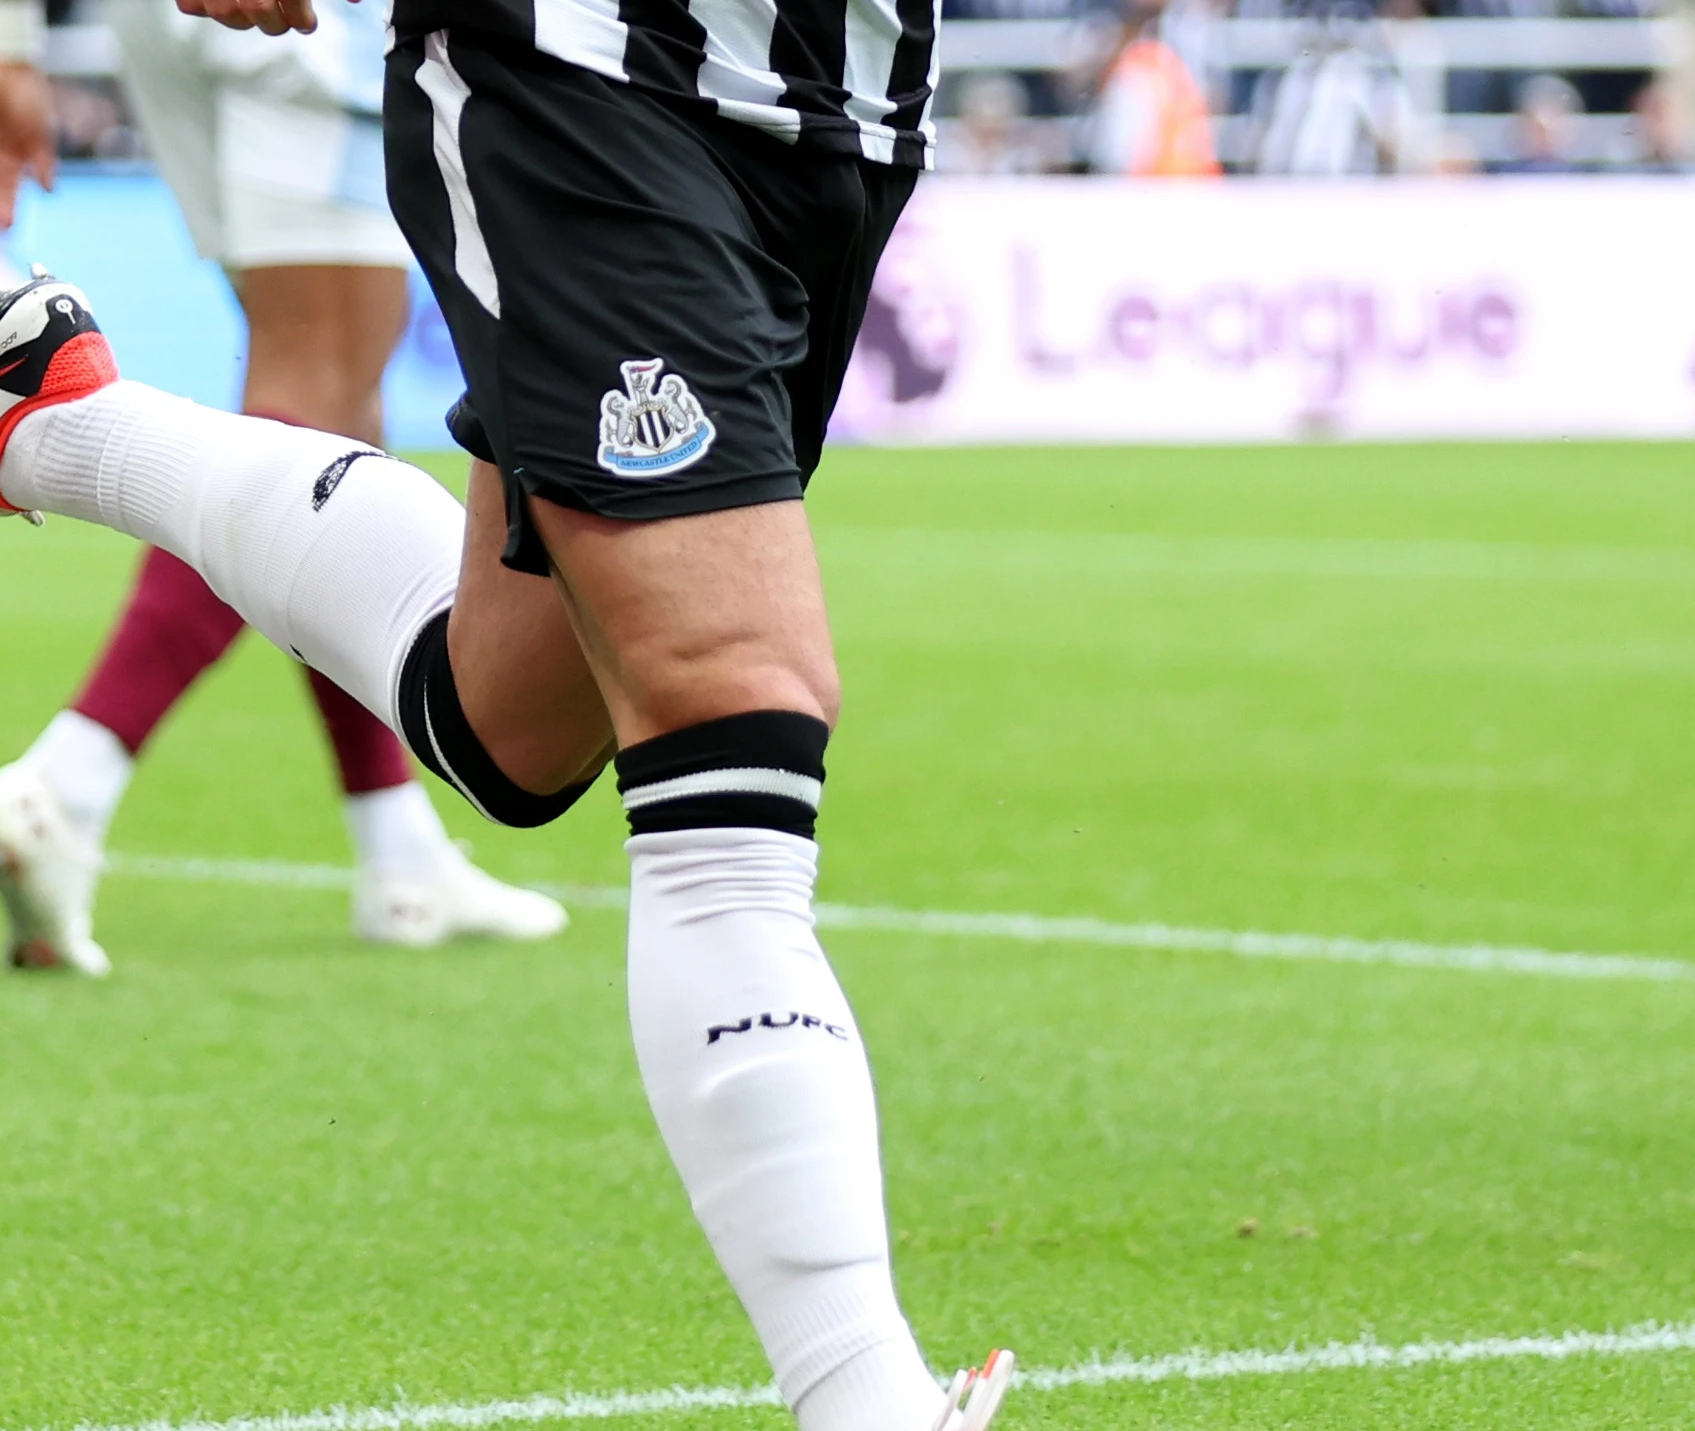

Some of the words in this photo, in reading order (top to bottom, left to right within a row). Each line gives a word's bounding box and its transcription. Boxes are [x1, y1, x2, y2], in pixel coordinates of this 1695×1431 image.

[1011, 243, 1520, 424] League
[620, 455, 670, 467] NEWCASTLE
[670, 440, 698, 460] UNITED
[707, 1012, 849, 1046] NUFC
